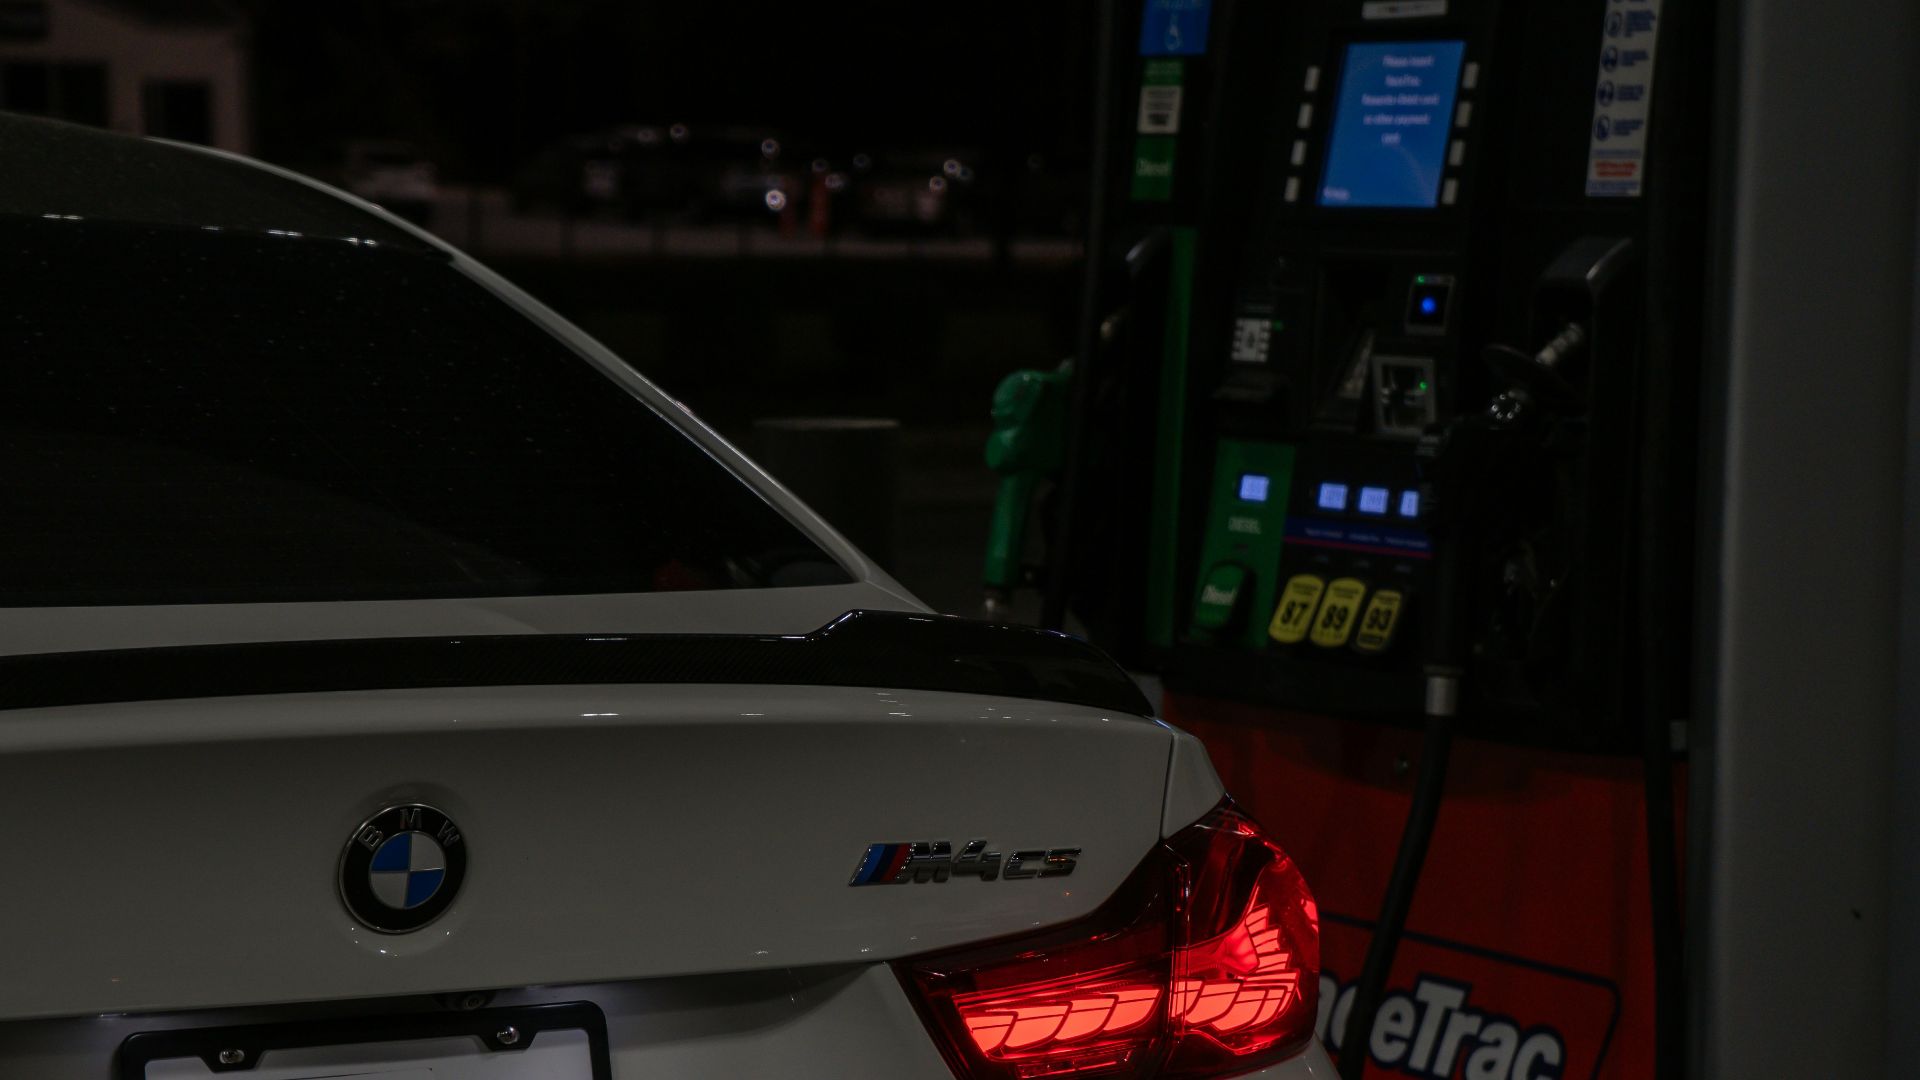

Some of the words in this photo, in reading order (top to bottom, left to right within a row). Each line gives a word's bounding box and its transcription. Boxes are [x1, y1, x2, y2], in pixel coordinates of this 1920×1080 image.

[1281, 601, 1308, 625] 87
[1321, 603, 1349, 630] 89
[1368, 608, 1392, 630] 93
[357, 808, 460, 851] BMW
[1316, 974, 1563, 1080] eTrac
